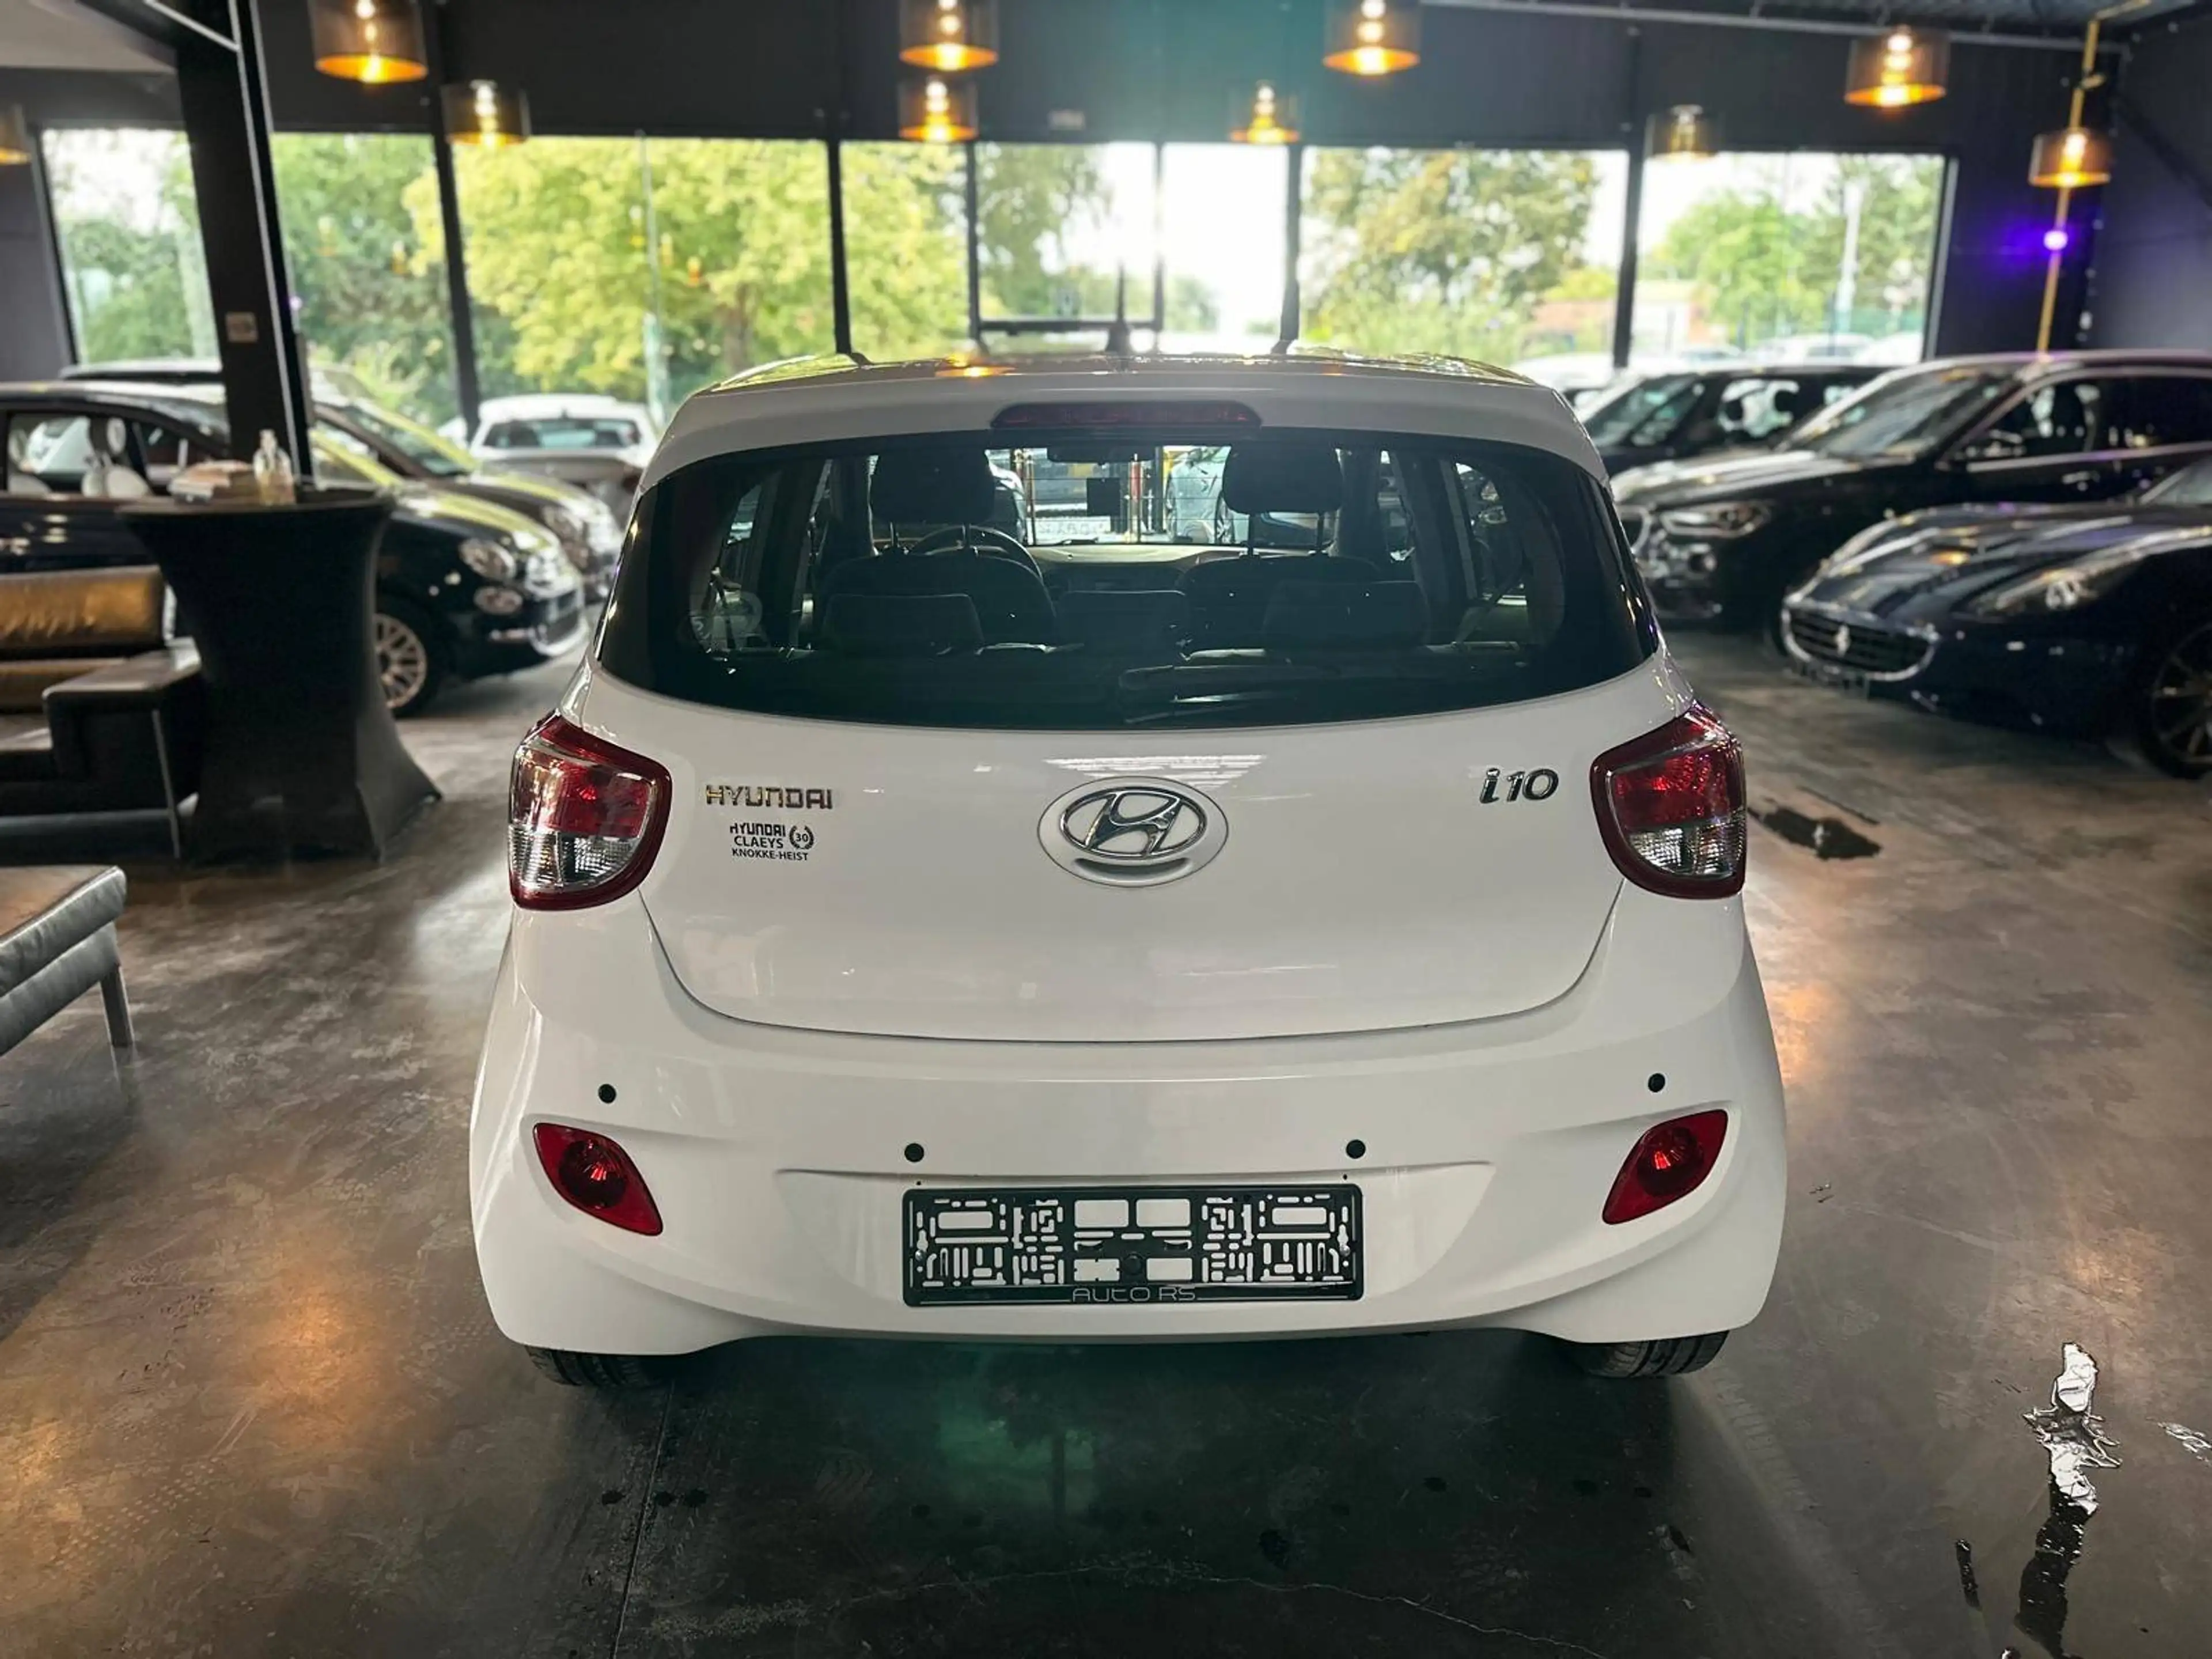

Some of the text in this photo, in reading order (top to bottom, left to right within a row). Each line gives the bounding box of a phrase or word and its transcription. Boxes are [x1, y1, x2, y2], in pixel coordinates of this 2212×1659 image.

[1479, 768, 1559, 804] i10
[706, 784, 833, 809] HYUNDAI
[729, 822, 786, 836] HYUNDAI
[734, 835, 783, 849] CLAEYS
[796, 833, 808, 842] 30
[732, 848, 809, 861] KNOKKE-HEIST
[1158, 1286, 1196, 1301] RS
